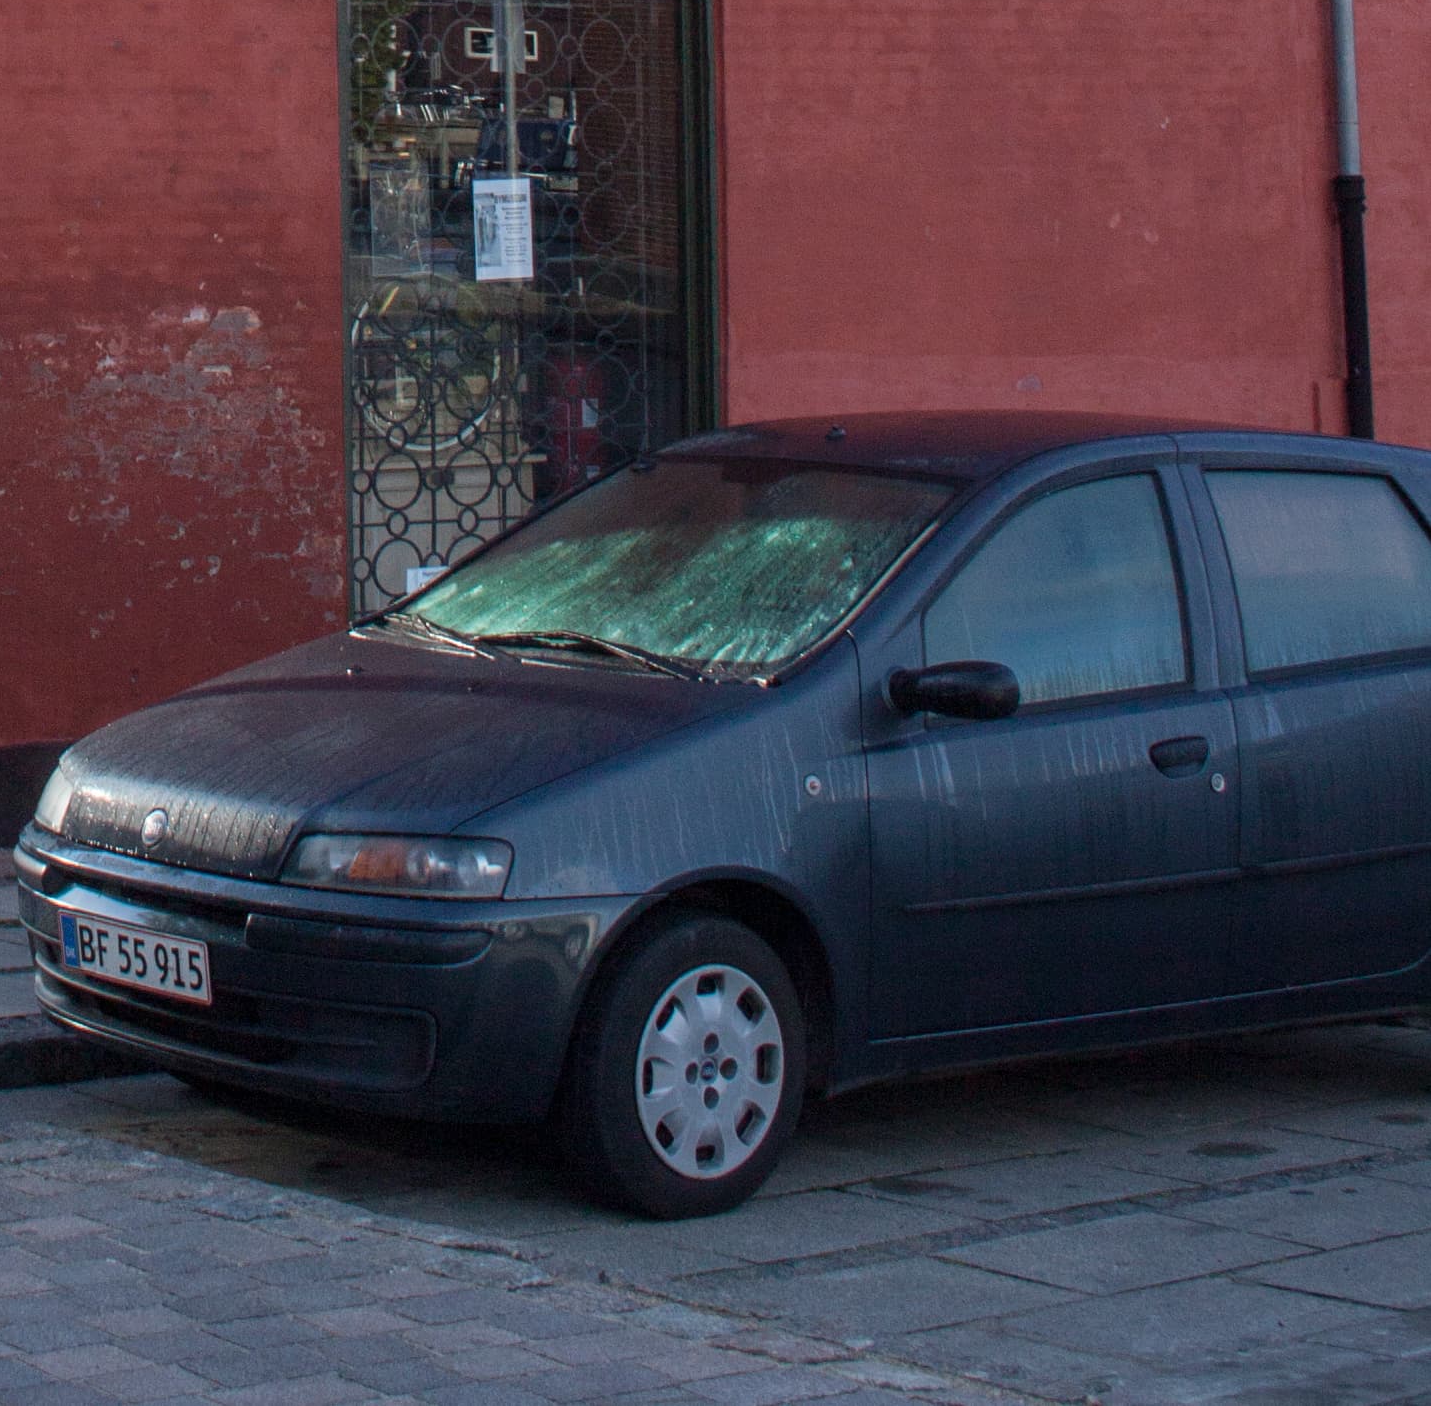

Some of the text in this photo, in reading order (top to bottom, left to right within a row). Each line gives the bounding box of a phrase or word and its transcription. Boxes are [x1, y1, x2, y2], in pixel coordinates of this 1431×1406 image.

[79, 925, 203, 990] BF 55 915
